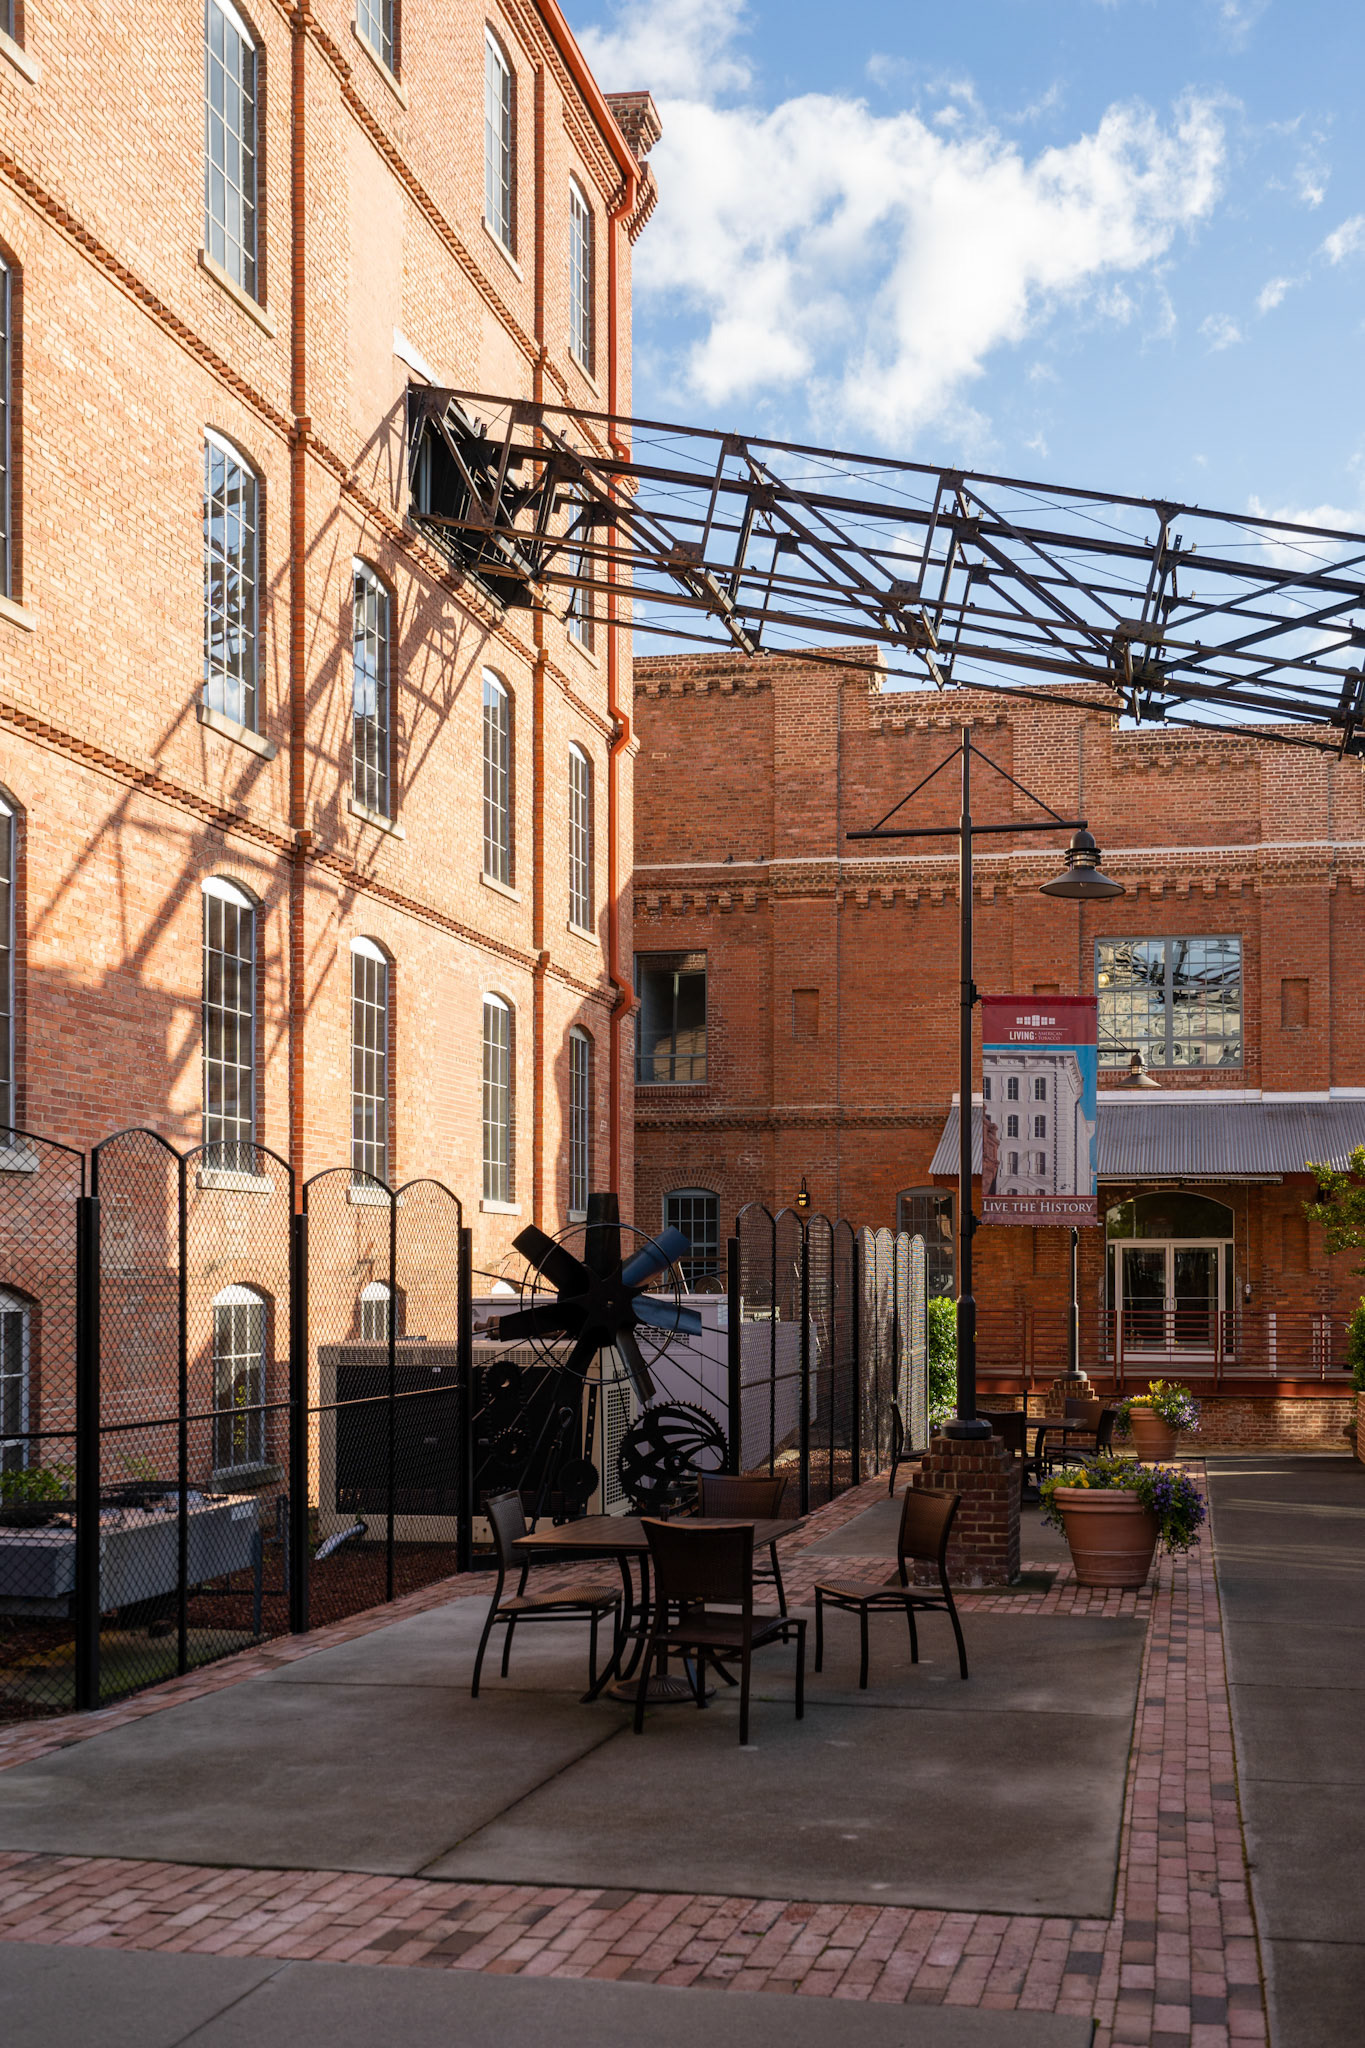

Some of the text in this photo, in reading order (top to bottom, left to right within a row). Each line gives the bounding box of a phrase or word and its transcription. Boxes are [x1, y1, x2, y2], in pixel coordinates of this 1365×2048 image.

[983, 1201, 1093, 1212] LIVE THE HISTORY
